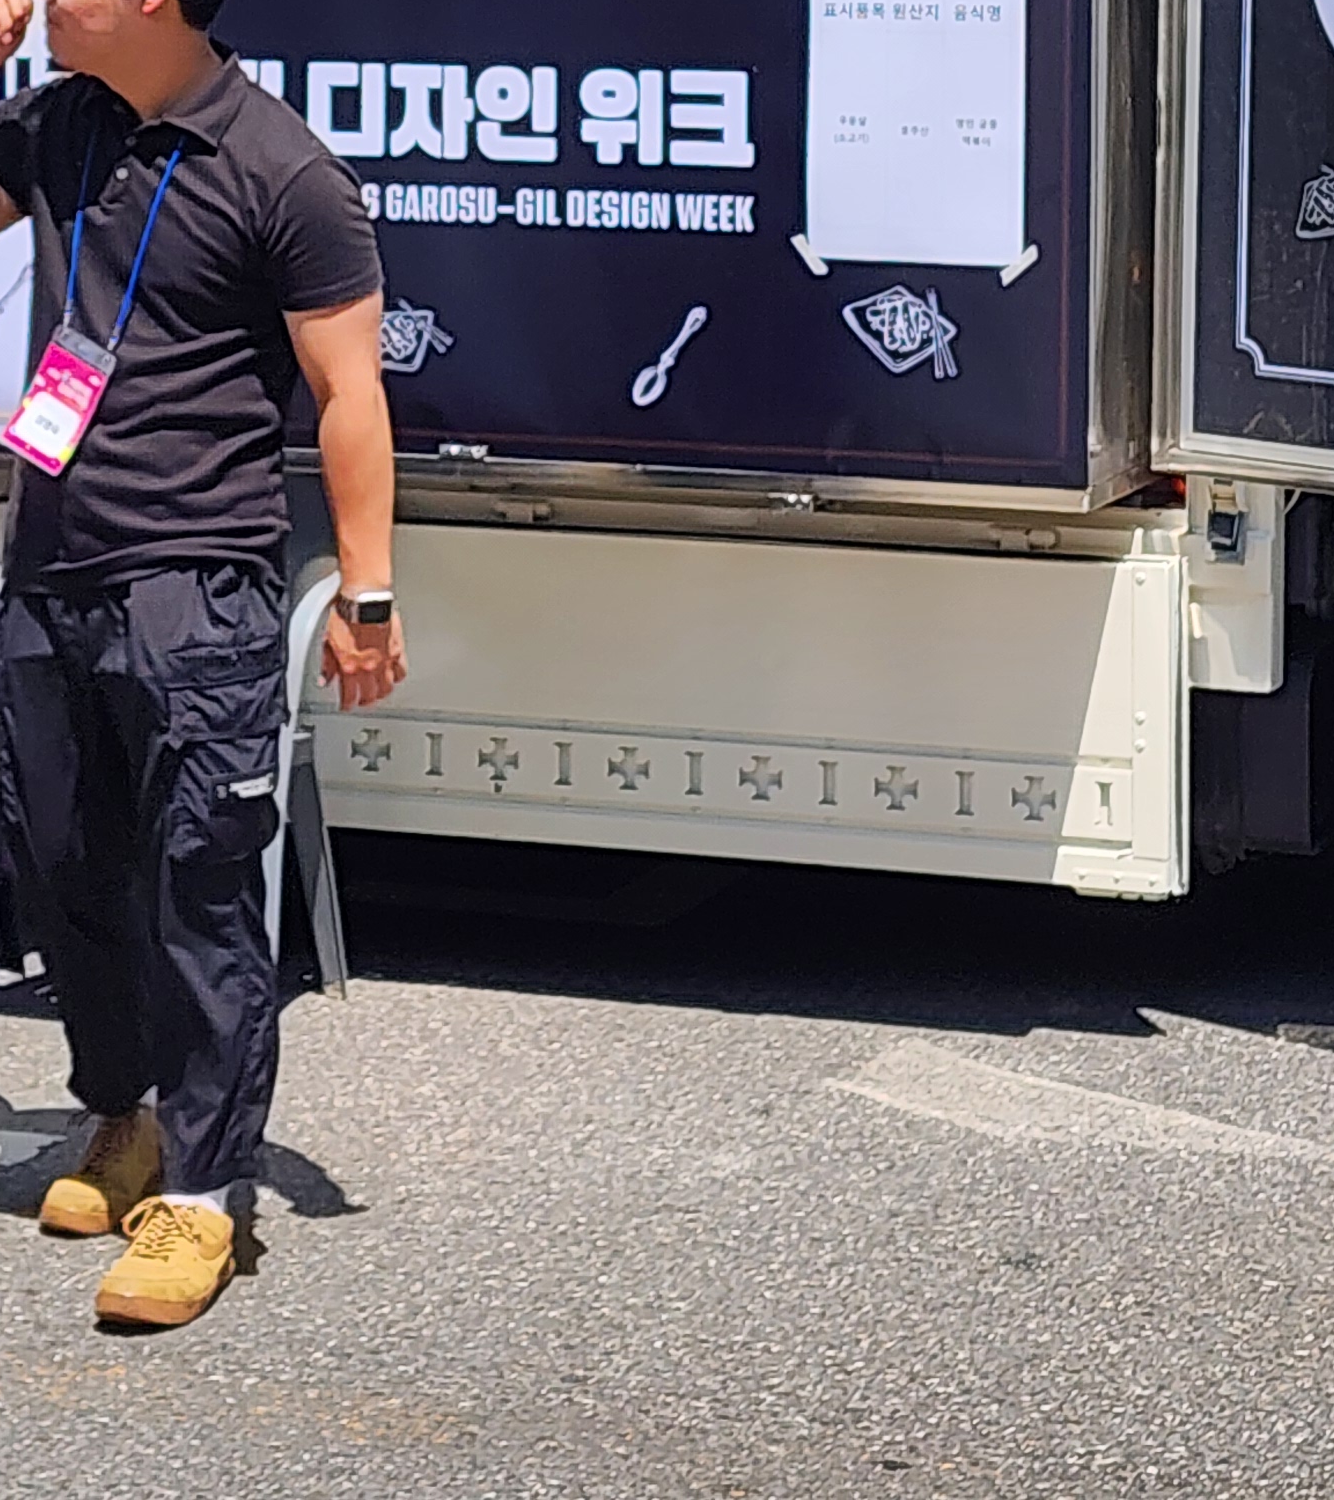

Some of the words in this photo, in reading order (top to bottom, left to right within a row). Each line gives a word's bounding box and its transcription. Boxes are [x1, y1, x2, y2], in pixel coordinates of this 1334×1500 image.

[823, 2, 886, 20] 표시품목
[892, 2, 940, 22] 원산지
[954, 4, 1002, 23] 음식명
[307, 61, 557, 162] 디자인
[579, 68, 756, 168] 위크
[384, 182, 562, 227] GAROSU-GIL
[566, 189, 671, 231] DESIGN
[674, 193, 756, 234] WEEK
